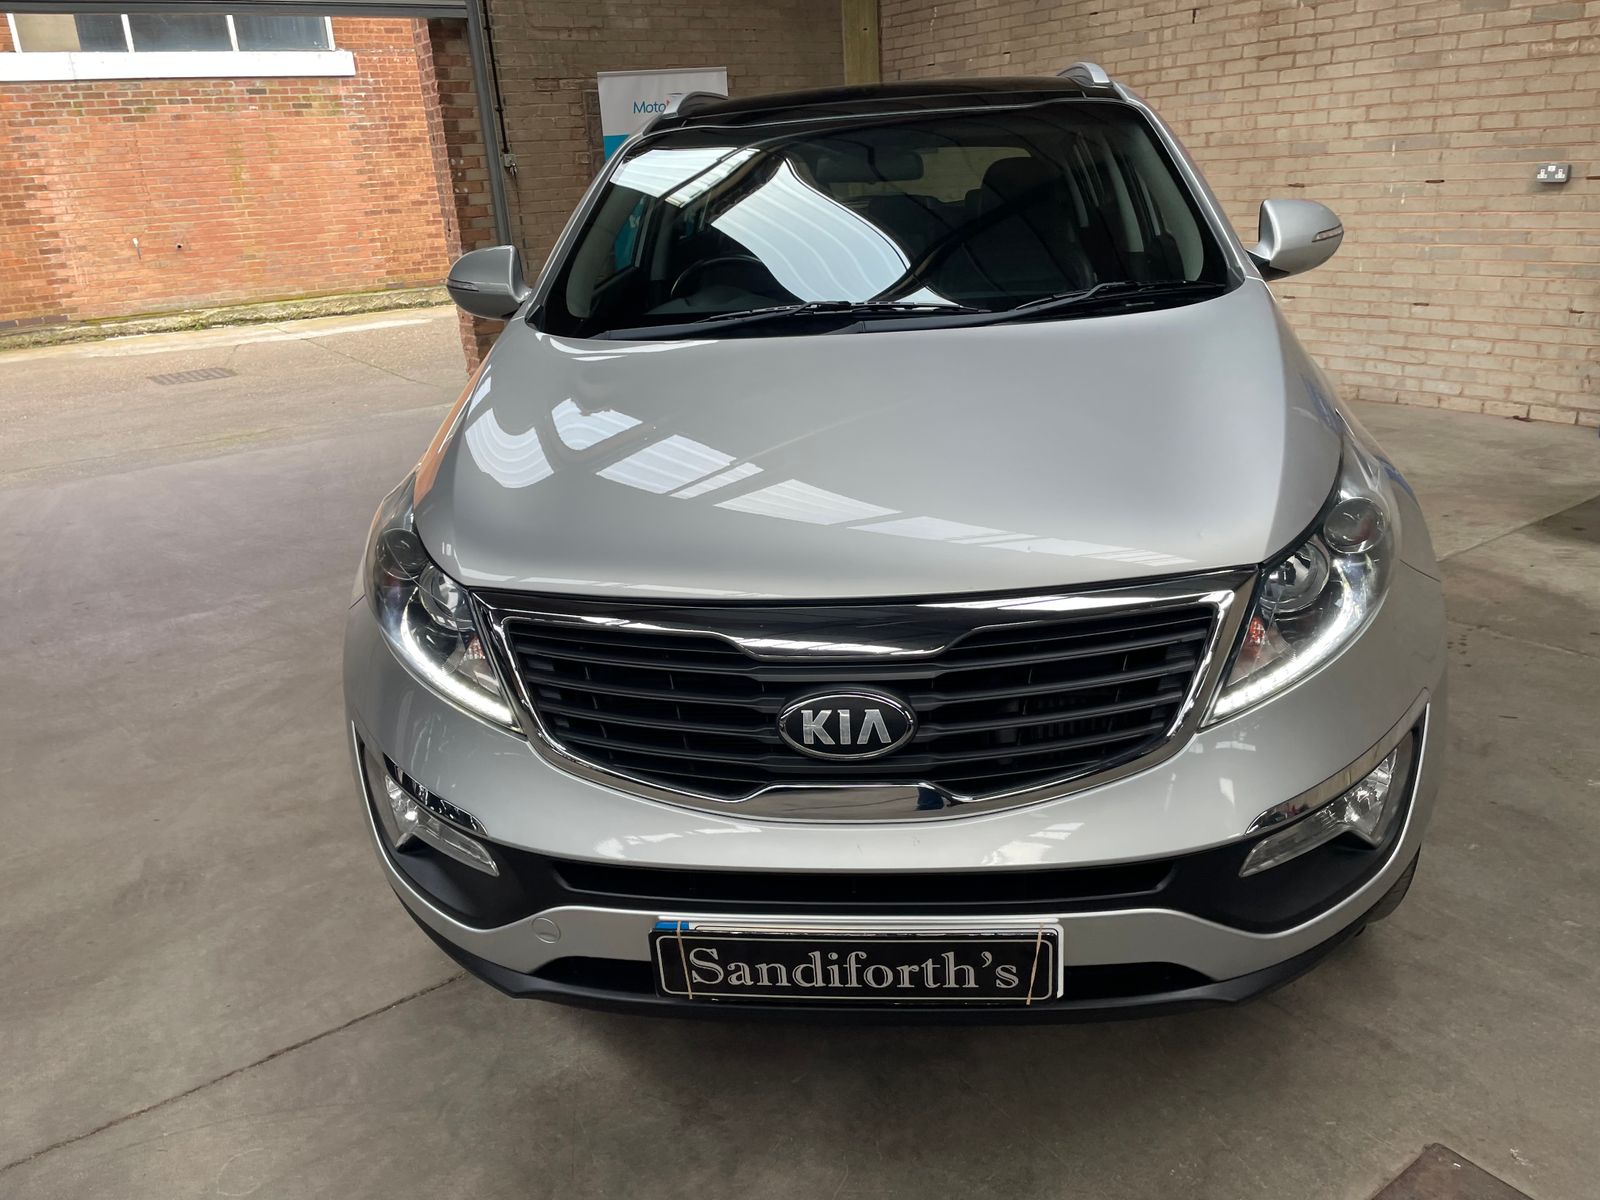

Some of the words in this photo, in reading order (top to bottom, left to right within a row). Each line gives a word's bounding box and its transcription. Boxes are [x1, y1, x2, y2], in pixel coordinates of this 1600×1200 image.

[633, 100, 670, 114] Moto
[801, 709, 892, 745] KIA
[689, 947, 1019, 989] Sandiforth's
